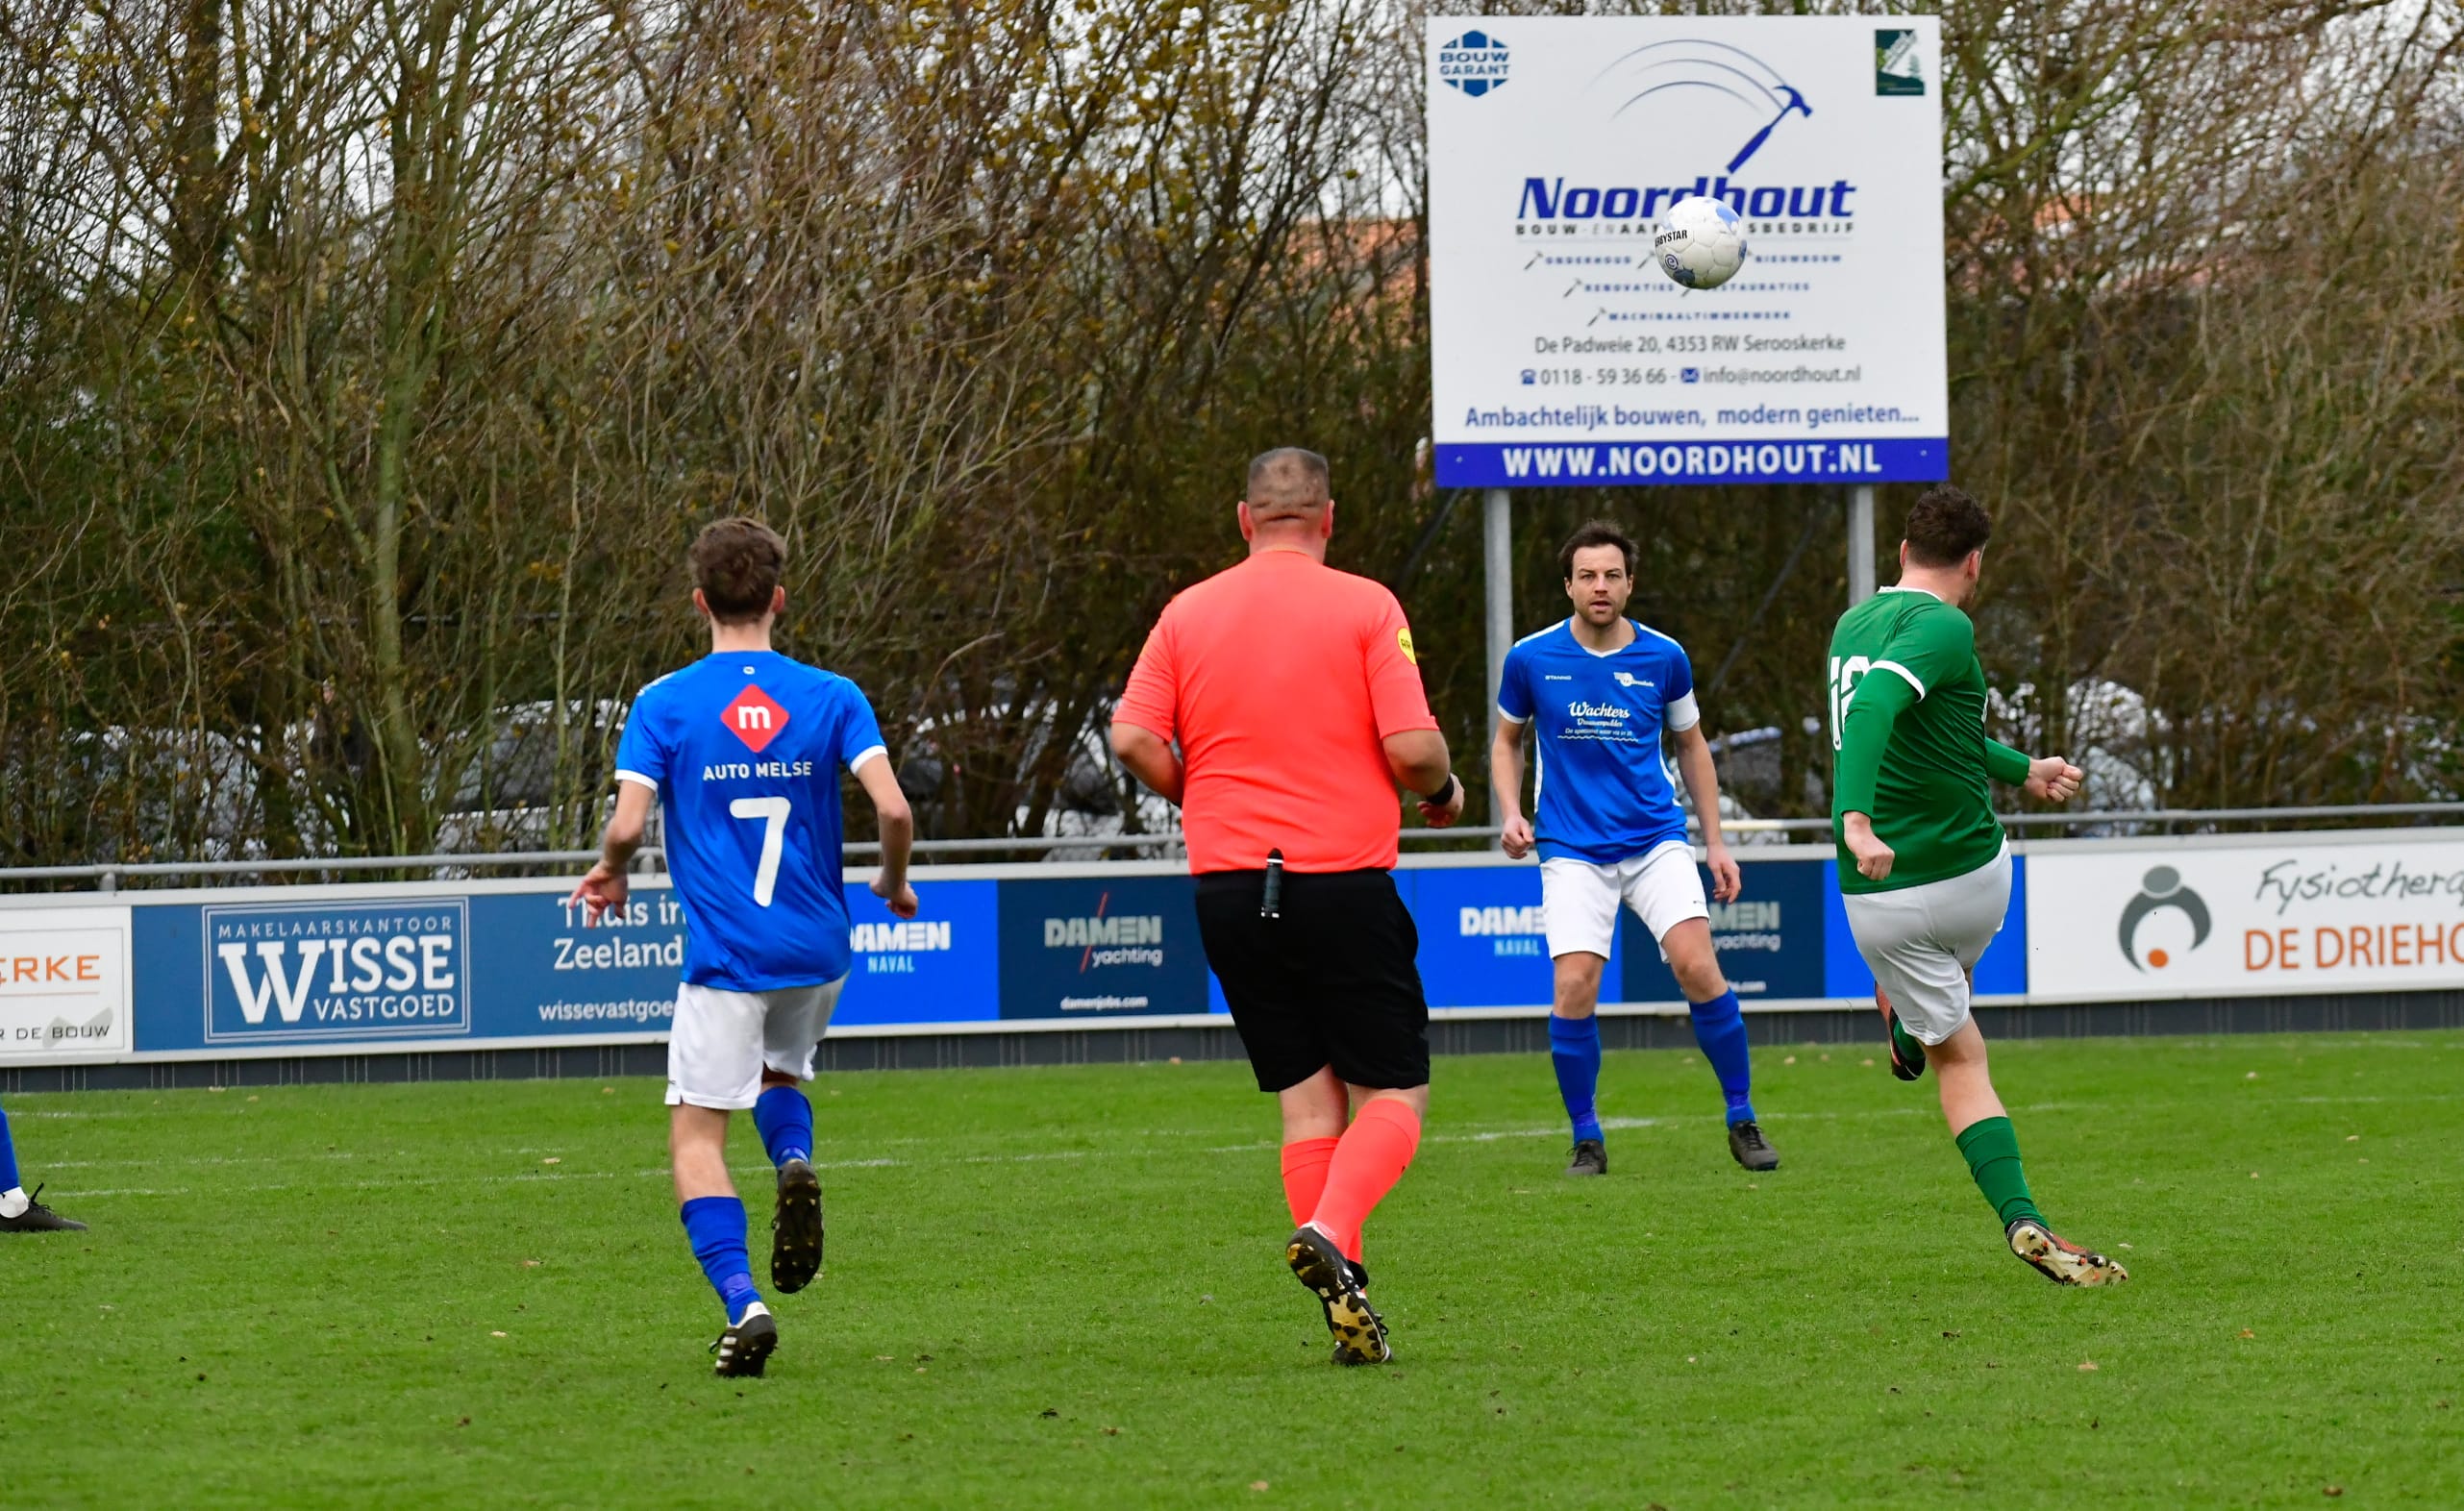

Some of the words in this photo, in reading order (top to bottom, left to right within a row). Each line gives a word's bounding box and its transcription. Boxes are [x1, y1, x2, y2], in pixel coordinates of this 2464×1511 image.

[1439, 63, 1509, 76] GARANT
[1440, 52, 1509, 62] BOUW
[1517, 176, 1857, 219] Noordhout
[1655, 230, 1688, 248] ERBYSTAR
[1711, 283, 1809, 291] STAURATIES
[1535, 336, 1557, 354] De
[1562, 335, 1632, 354] Padweie
[1638, 336, 1661, 355] 20,
[1666, 335, 1707, 353] 4353
[1712, 334, 1739, 352] RW
[1744, 334, 1846, 352] Serooskerke
[1540, 369, 1582, 385] 0118
[1597, 369, 1617, 385] 59
[1622, 368, 1642, 384] 36
[1645, 368, 1667, 384] 66
[1703, 365, 1861, 385] info@noordhout.nl
[1465, 405, 1607, 432] Ambachtelijk
[1615, 404, 1705, 428] bouwen,
[1717, 403, 1801, 425] modern
[1808, 405, 1919, 431] genieten...
[1504, 445, 1881, 478] WWW.NOORDHOUT.NL
[737, 706, 771, 730] m
[1568, 701, 1630, 719] Wachters
[703, 763, 750, 780] AUTO
[757, 761, 812, 778] MELSE
[730, 796, 791, 907] 7
[2255, 859, 2464, 916] Fysiothera
[218, 916, 453, 940] MAKELAARSKANTOOR
[1459, 904, 1548, 936] DAME
[1708, 901, 1780, 930] MEN
[850, 921, 951, 953] AMEN
[1044, 915, 1162, 948] DAMEN
[553, 934, 684, 970] Zeeland
[1092, 947, 1163, 968] yachting
[1494, 939, 1541, 956] NAVAL
[2245, 928, 2300, 971] DE
[0, 954, 100, 982] RKE
[867, 954, 916, 974] NAVAL
[218, 934, 454, 1025] WISSE
[314, 995, 455, 1021] VASTGOED
[538, 999, 676, 1024] wissevastgoe
[16, 1027, 42, 1040] DE
[53, 1025, 110, 1040] BOUW
